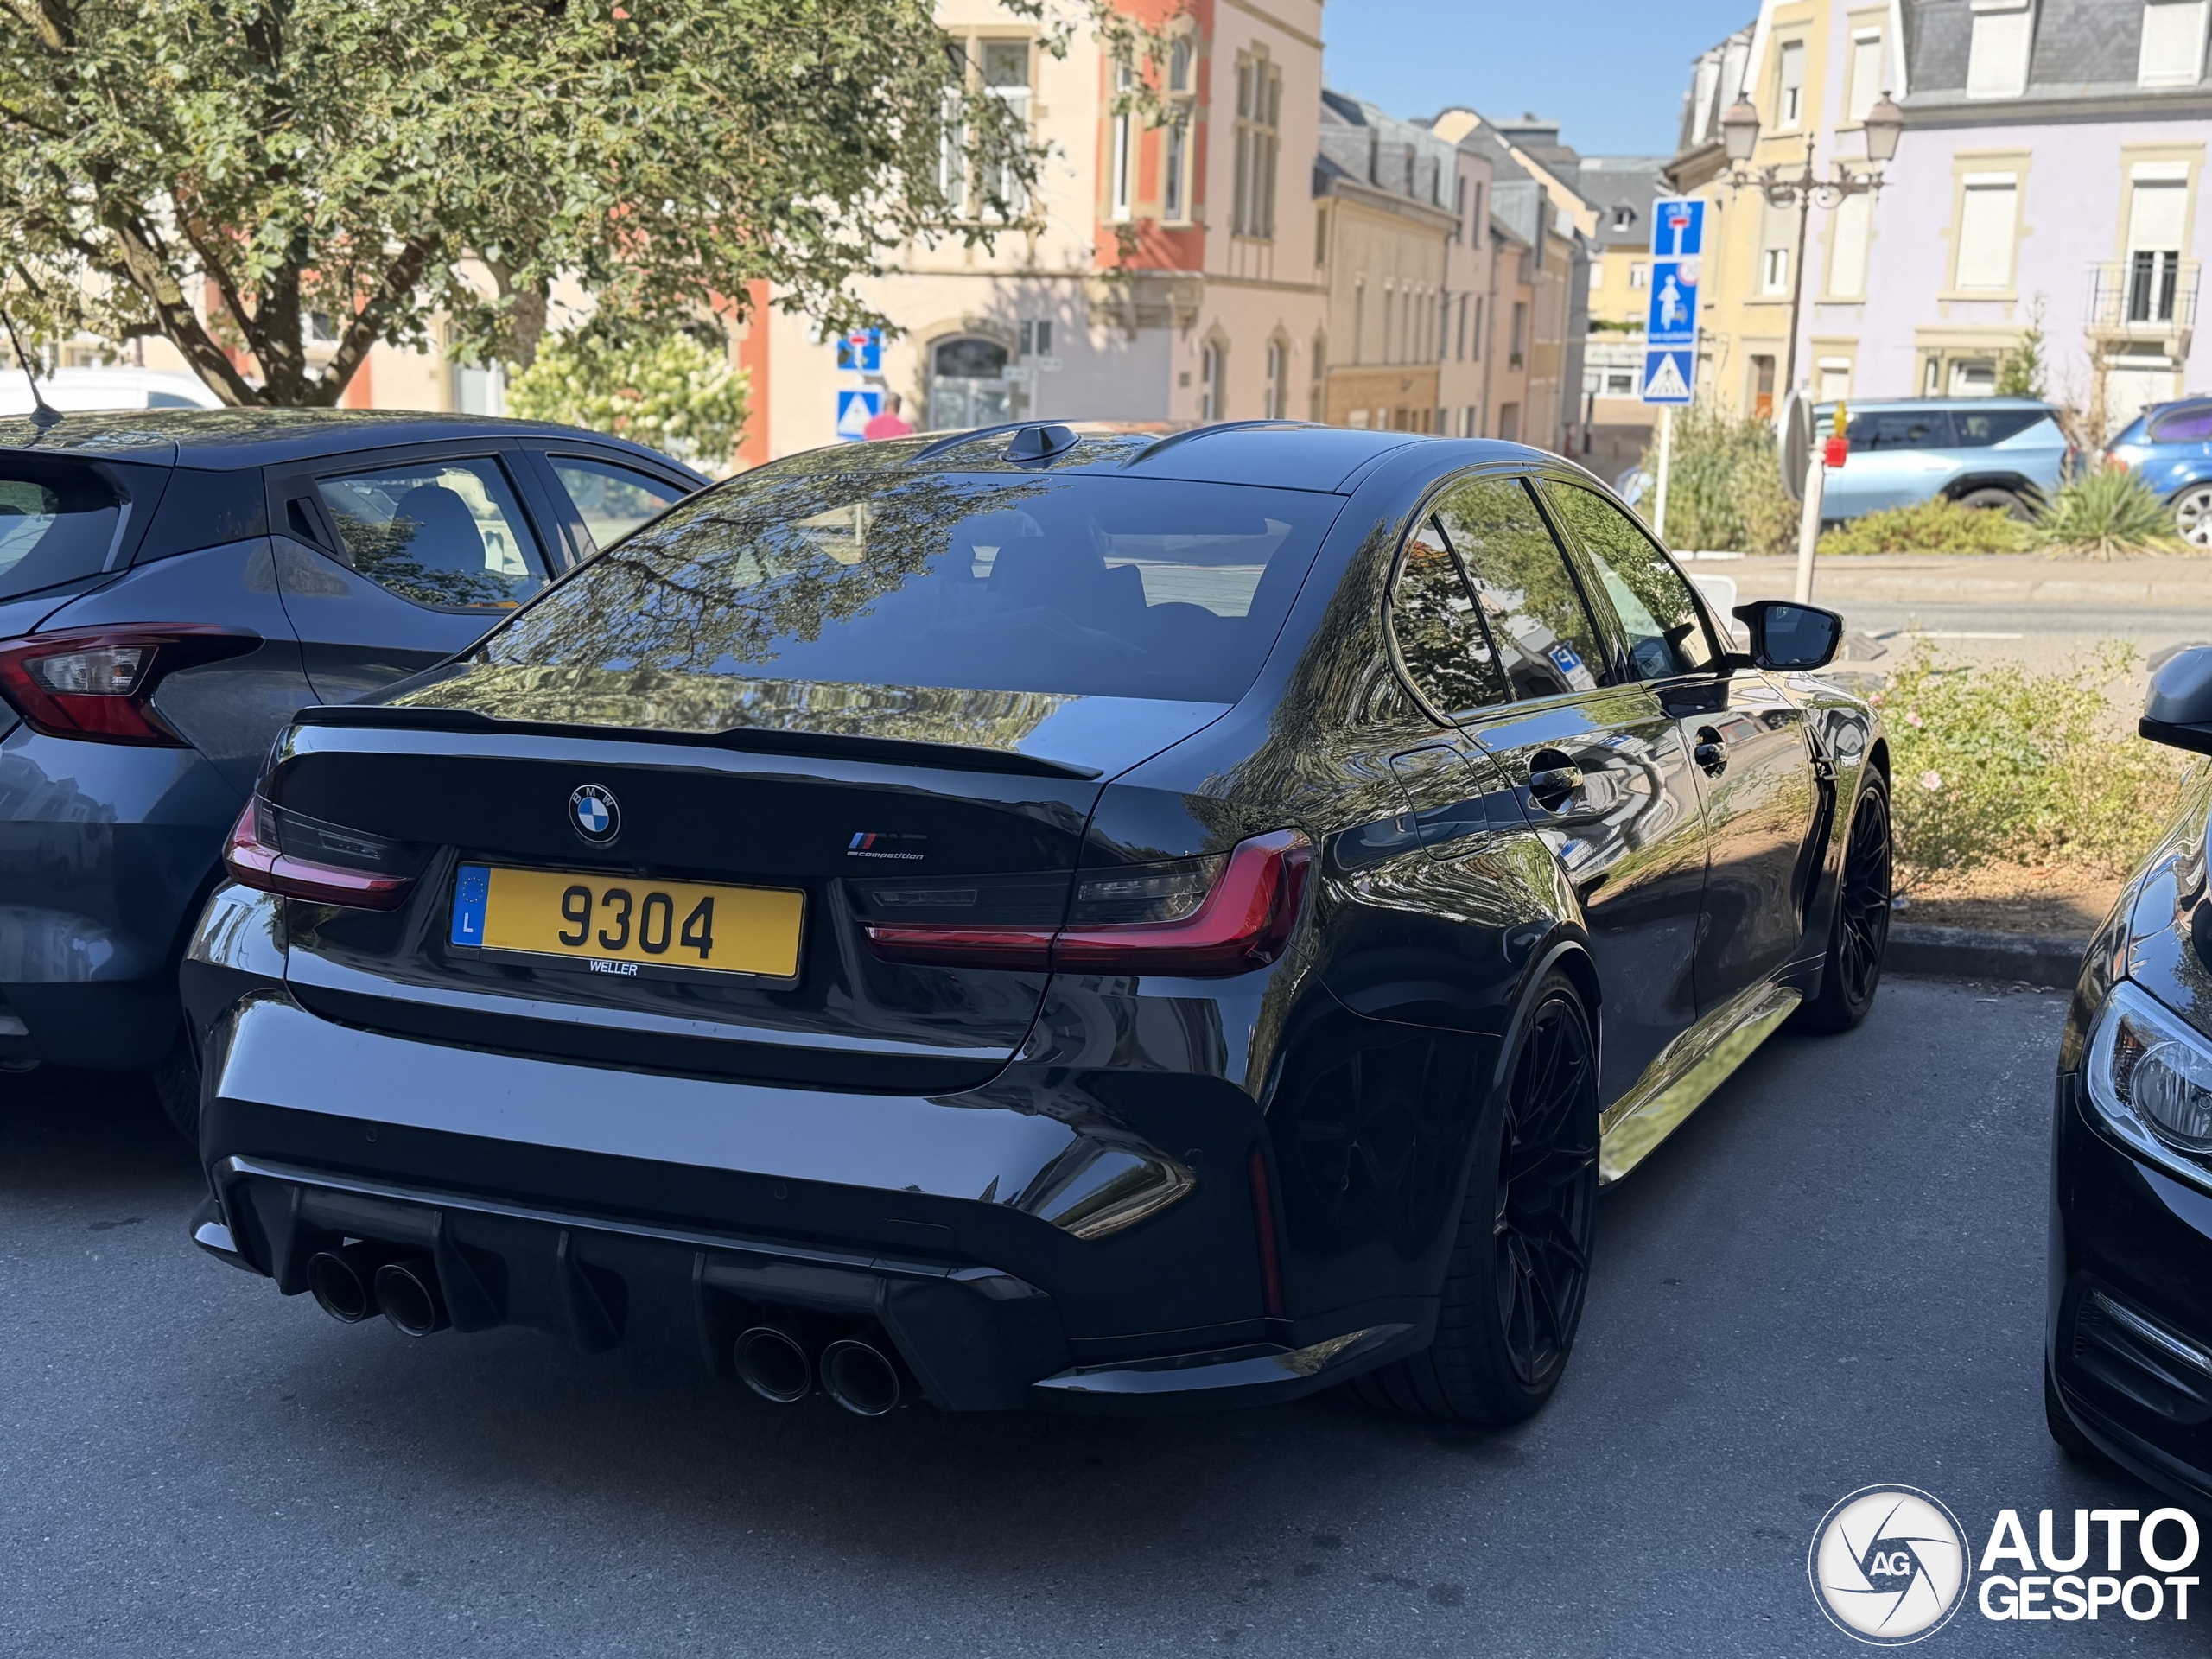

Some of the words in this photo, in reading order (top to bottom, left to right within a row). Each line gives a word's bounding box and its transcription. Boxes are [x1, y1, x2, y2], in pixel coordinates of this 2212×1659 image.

[572, 787, 613, 807] BMW
[462, 912, 474, 933] L
[558, 885, 715, 959] 9304
[590, 960, 638, 976] WELLER
